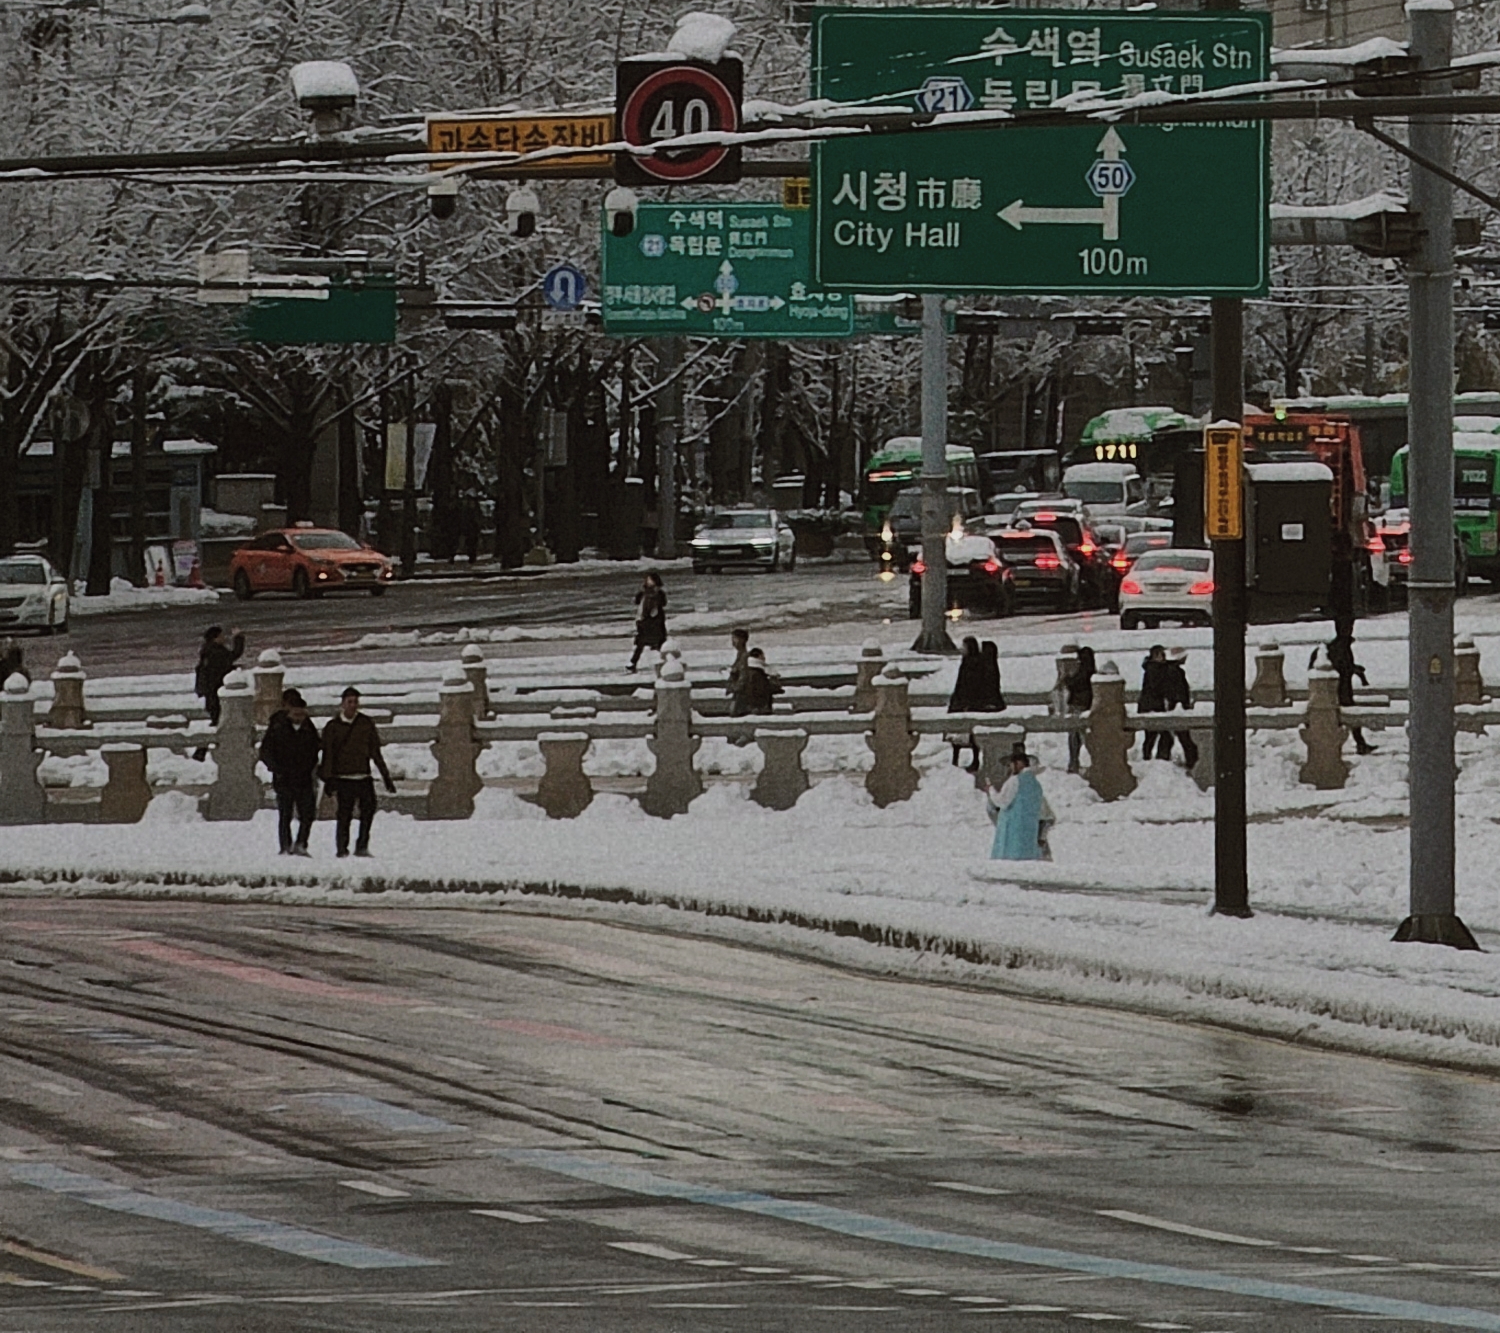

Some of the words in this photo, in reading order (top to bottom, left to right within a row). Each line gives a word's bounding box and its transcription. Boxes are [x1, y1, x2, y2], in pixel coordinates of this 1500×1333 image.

[979, 26, 1101, 67] 수색역
[1118, 40, 1205, 69] Susaek
[1212, 42, 1252, 70] Stn
[930, 88, 960, 111] 21
[650, 98, 709, 137] 40
[832, 170, 908, 212] 시청
[916, 176, 983, 211] 市廳
[1097, 166, 1124, 189] 50
[833, 220, 893, 253] City
[905, 222, 960, 248] Hall
[1078, 248, 1148, 276] 100m
[1095, 443, 1137, 460] 1711
